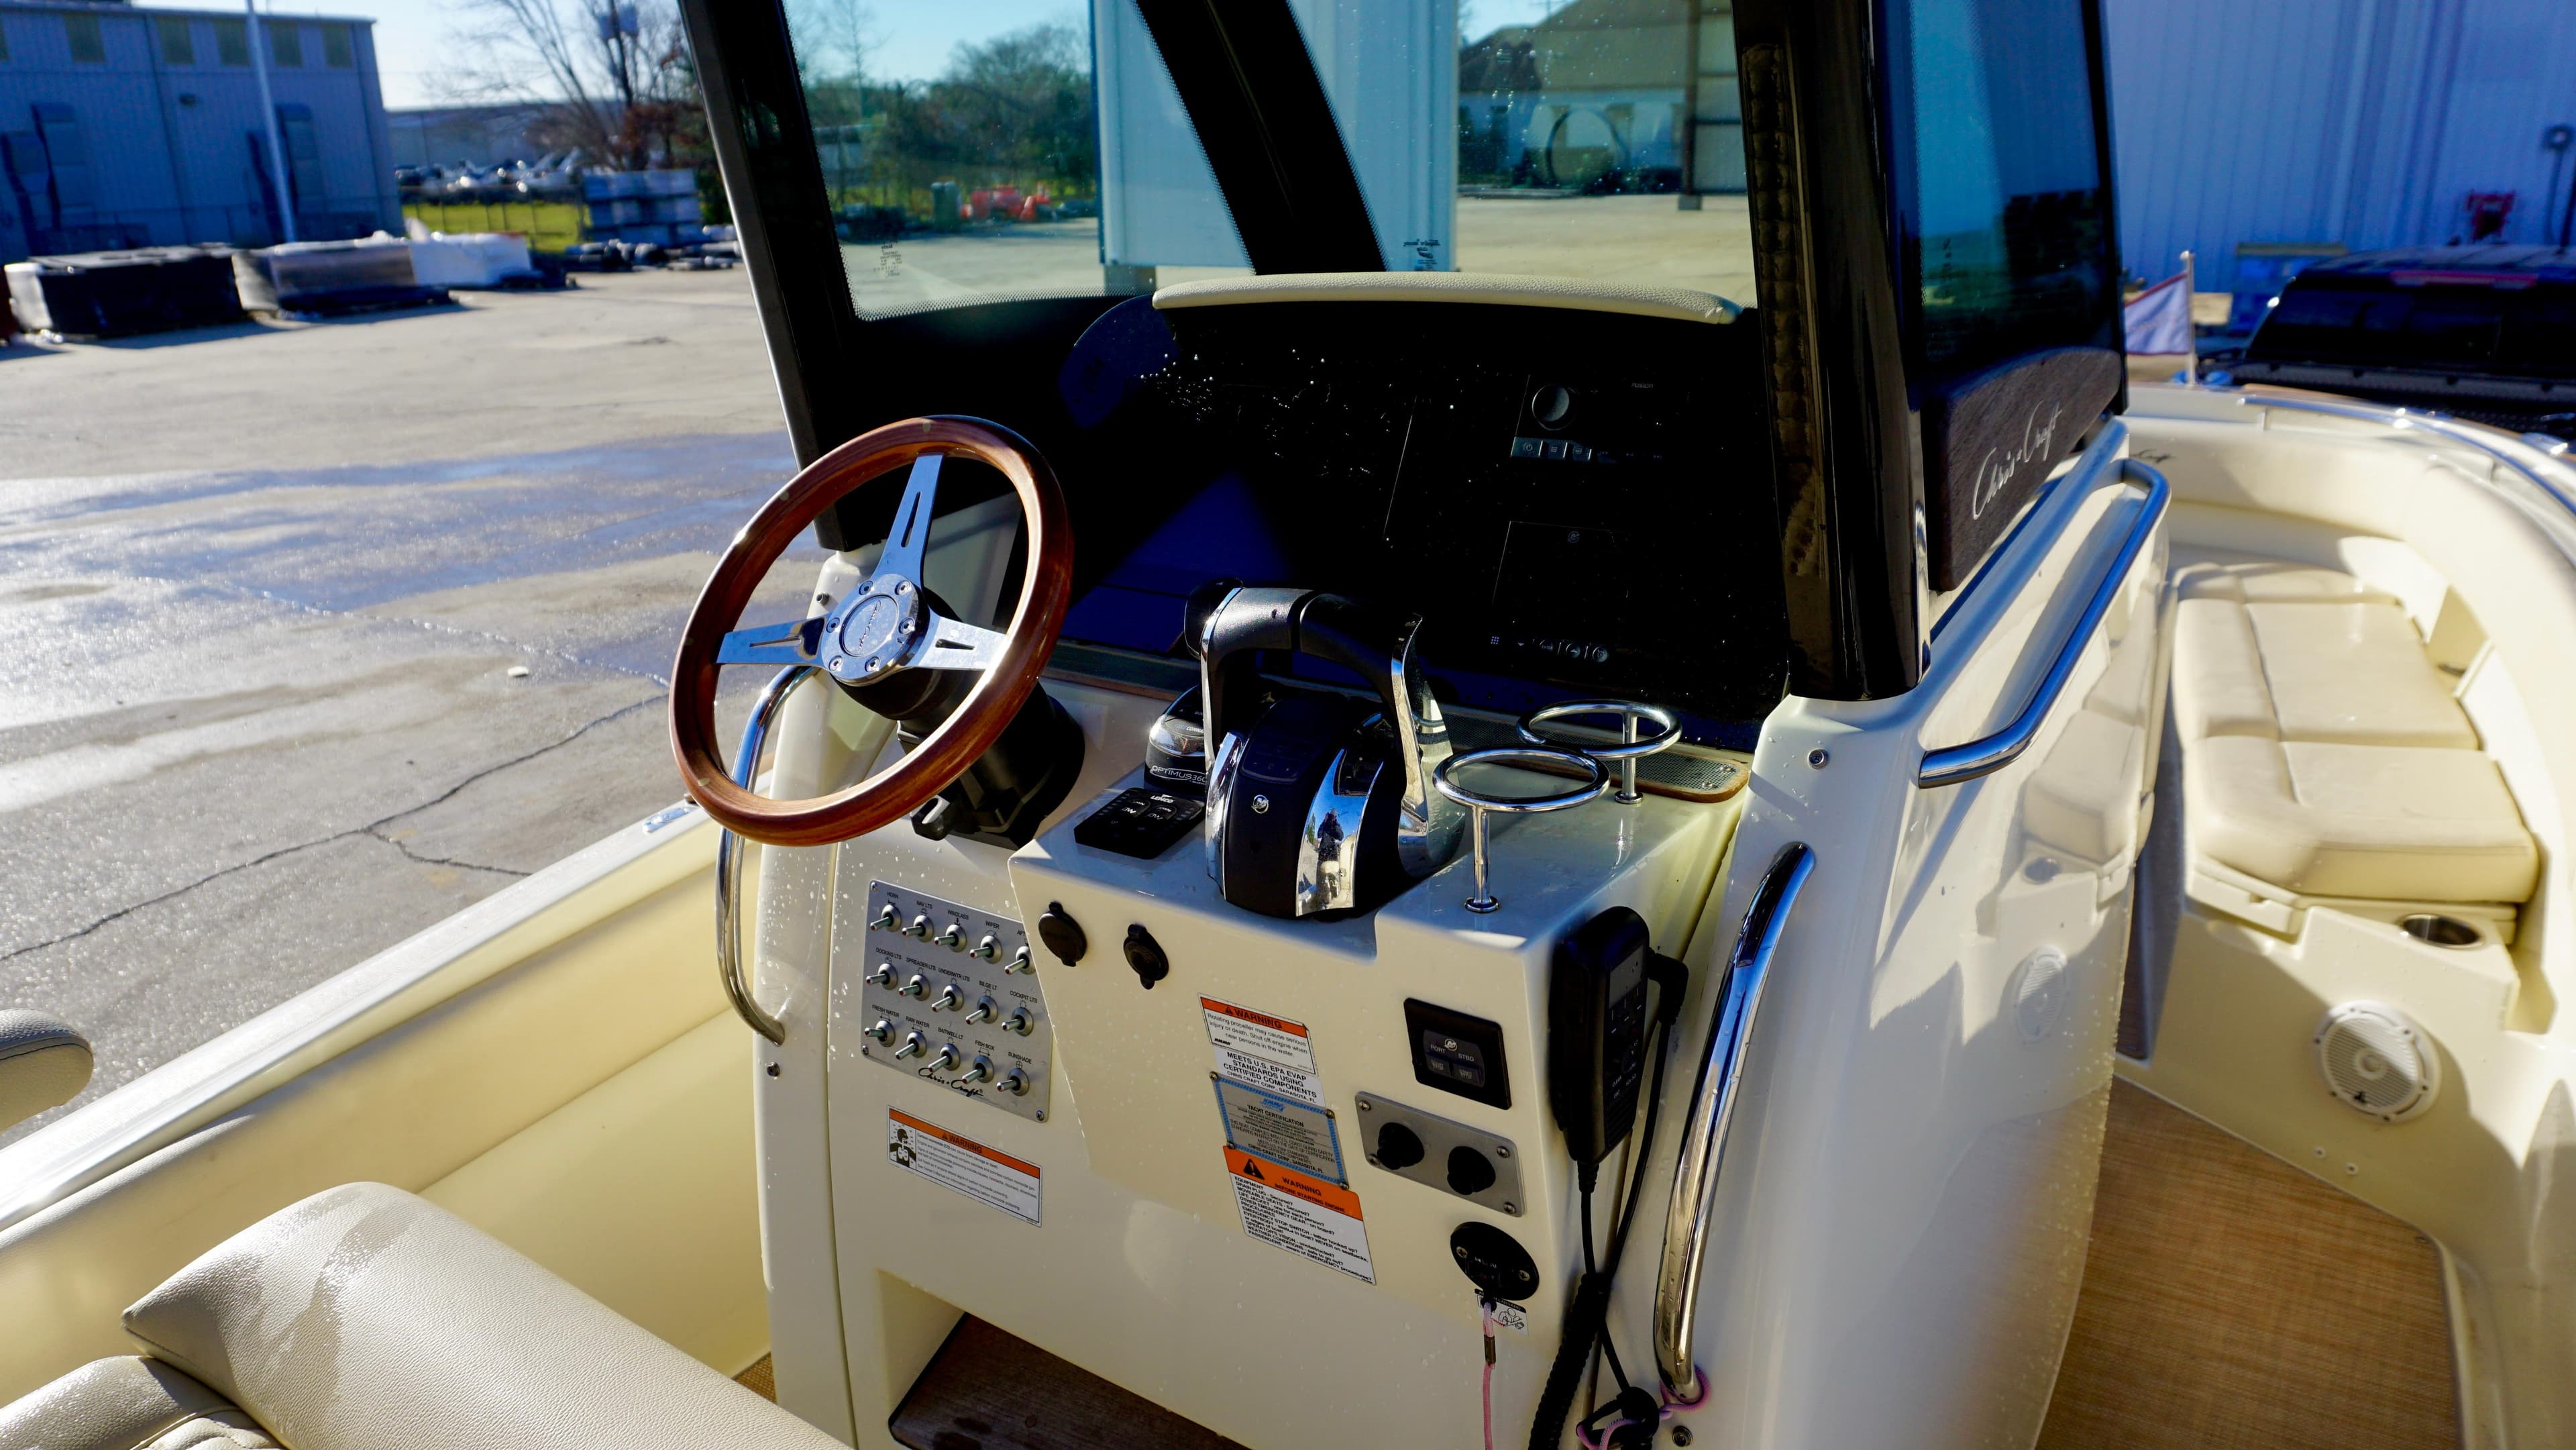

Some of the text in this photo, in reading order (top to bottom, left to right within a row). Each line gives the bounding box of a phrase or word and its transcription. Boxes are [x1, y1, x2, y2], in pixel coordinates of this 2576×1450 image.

[887, 891, 898, 899] HORN
[947, 909, 969, 920] WINDLASS
[985, 921, 999, 929] WIPER
[875, 947, 894, 957] DOCKING
[906, 957, 927, 968] SPREADER
[938, 967, 961, 979] UNDERWTR
[979, 980, 990, 988] BILGE
[1010, 990, 1028, 1000] COCKPIT
[872, 1004, 899, 1017] FRESH WATER
[915, 1019, 929, 1028] WATER
[1234, 1008, 1283, 1029] WARNING
[938, 1027, 957, 1038] BAITWELL
[1207, 1013, 1230, 1024] Rotating
[1230, 1019, 1254, 1031] propeller
[1267, 1031, 1285, 1040] cause
[1285, 1037, 1306, 1047] serious
[975, 1039, 994, 1051] FISH BOX
[1231, 1027, 1248, 1036] death.
[1250, 1033, 1263, 1041] Shut
[1272, 1039, 1291, 1050] engine
[1292, 1045, 1307, 1054] when
[1238, 1037, 1260, 1047] persons
[1277, 1048, 1293, 1057] water.
[1430, 1043, 1446, 1054] PORT
[1008, 1051, 1031, 1064] SUNSHADE
[1226, 1051, 1252, 1064] MEETS
[1253, 1059, 1268, 1070] U.S.
[1269, 1065, 1285, 1075] EPA
[1286, 1070, 1307, 1082] EVAP
[1232, 1059, 1278, 1079] STANDARDS
[1279, 1074, 1303, 1087] USING
[1223, 1062, 1317, 1098] CERTIFIED COMPONENTS
[1247, 1104, 1264, 1114] YACHT
[1265, 1110, 1304, 1127] CERTIFICATION
[949, 1134, 981, 1153] WARNING
[1234, 1176, 1264, 1190] EQUIPMENT
[1282, 1176, 1322, 1196] WARNING
[1236, 1181, 1293, 1206] DRAIN PLUG Secured?
[1236, 1186, 1309, 1216] MOVEABLE SEATS Secured?
[1240, 1201, 1275, 1217] PROCEDURES
